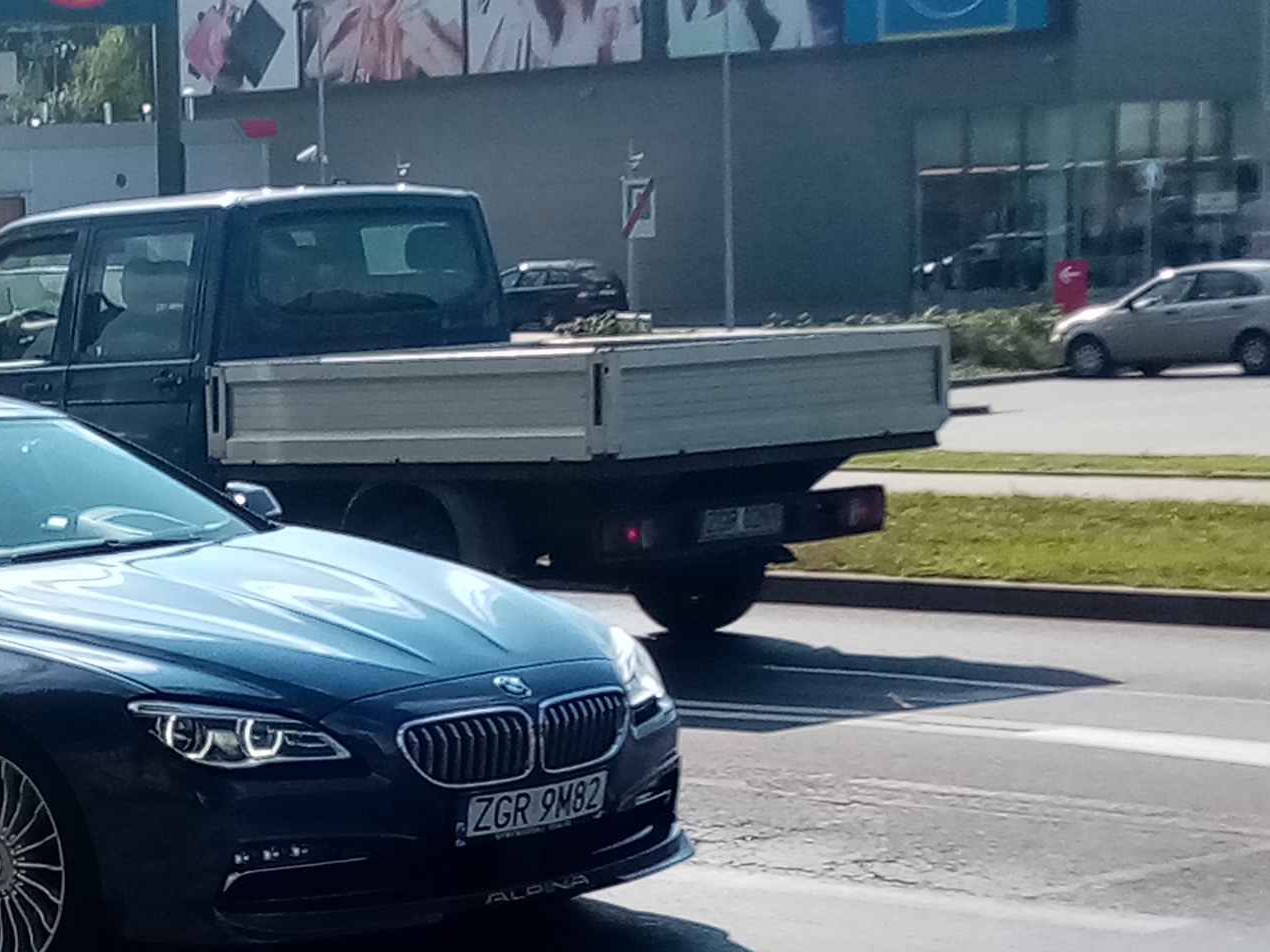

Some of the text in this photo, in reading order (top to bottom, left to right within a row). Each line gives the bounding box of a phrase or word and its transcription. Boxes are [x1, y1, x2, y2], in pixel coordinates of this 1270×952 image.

[473, 792, 531, 833] ZGR
[538, 776, 601, 823] 9M82
[485, 873, 590, 905] ALPINA
